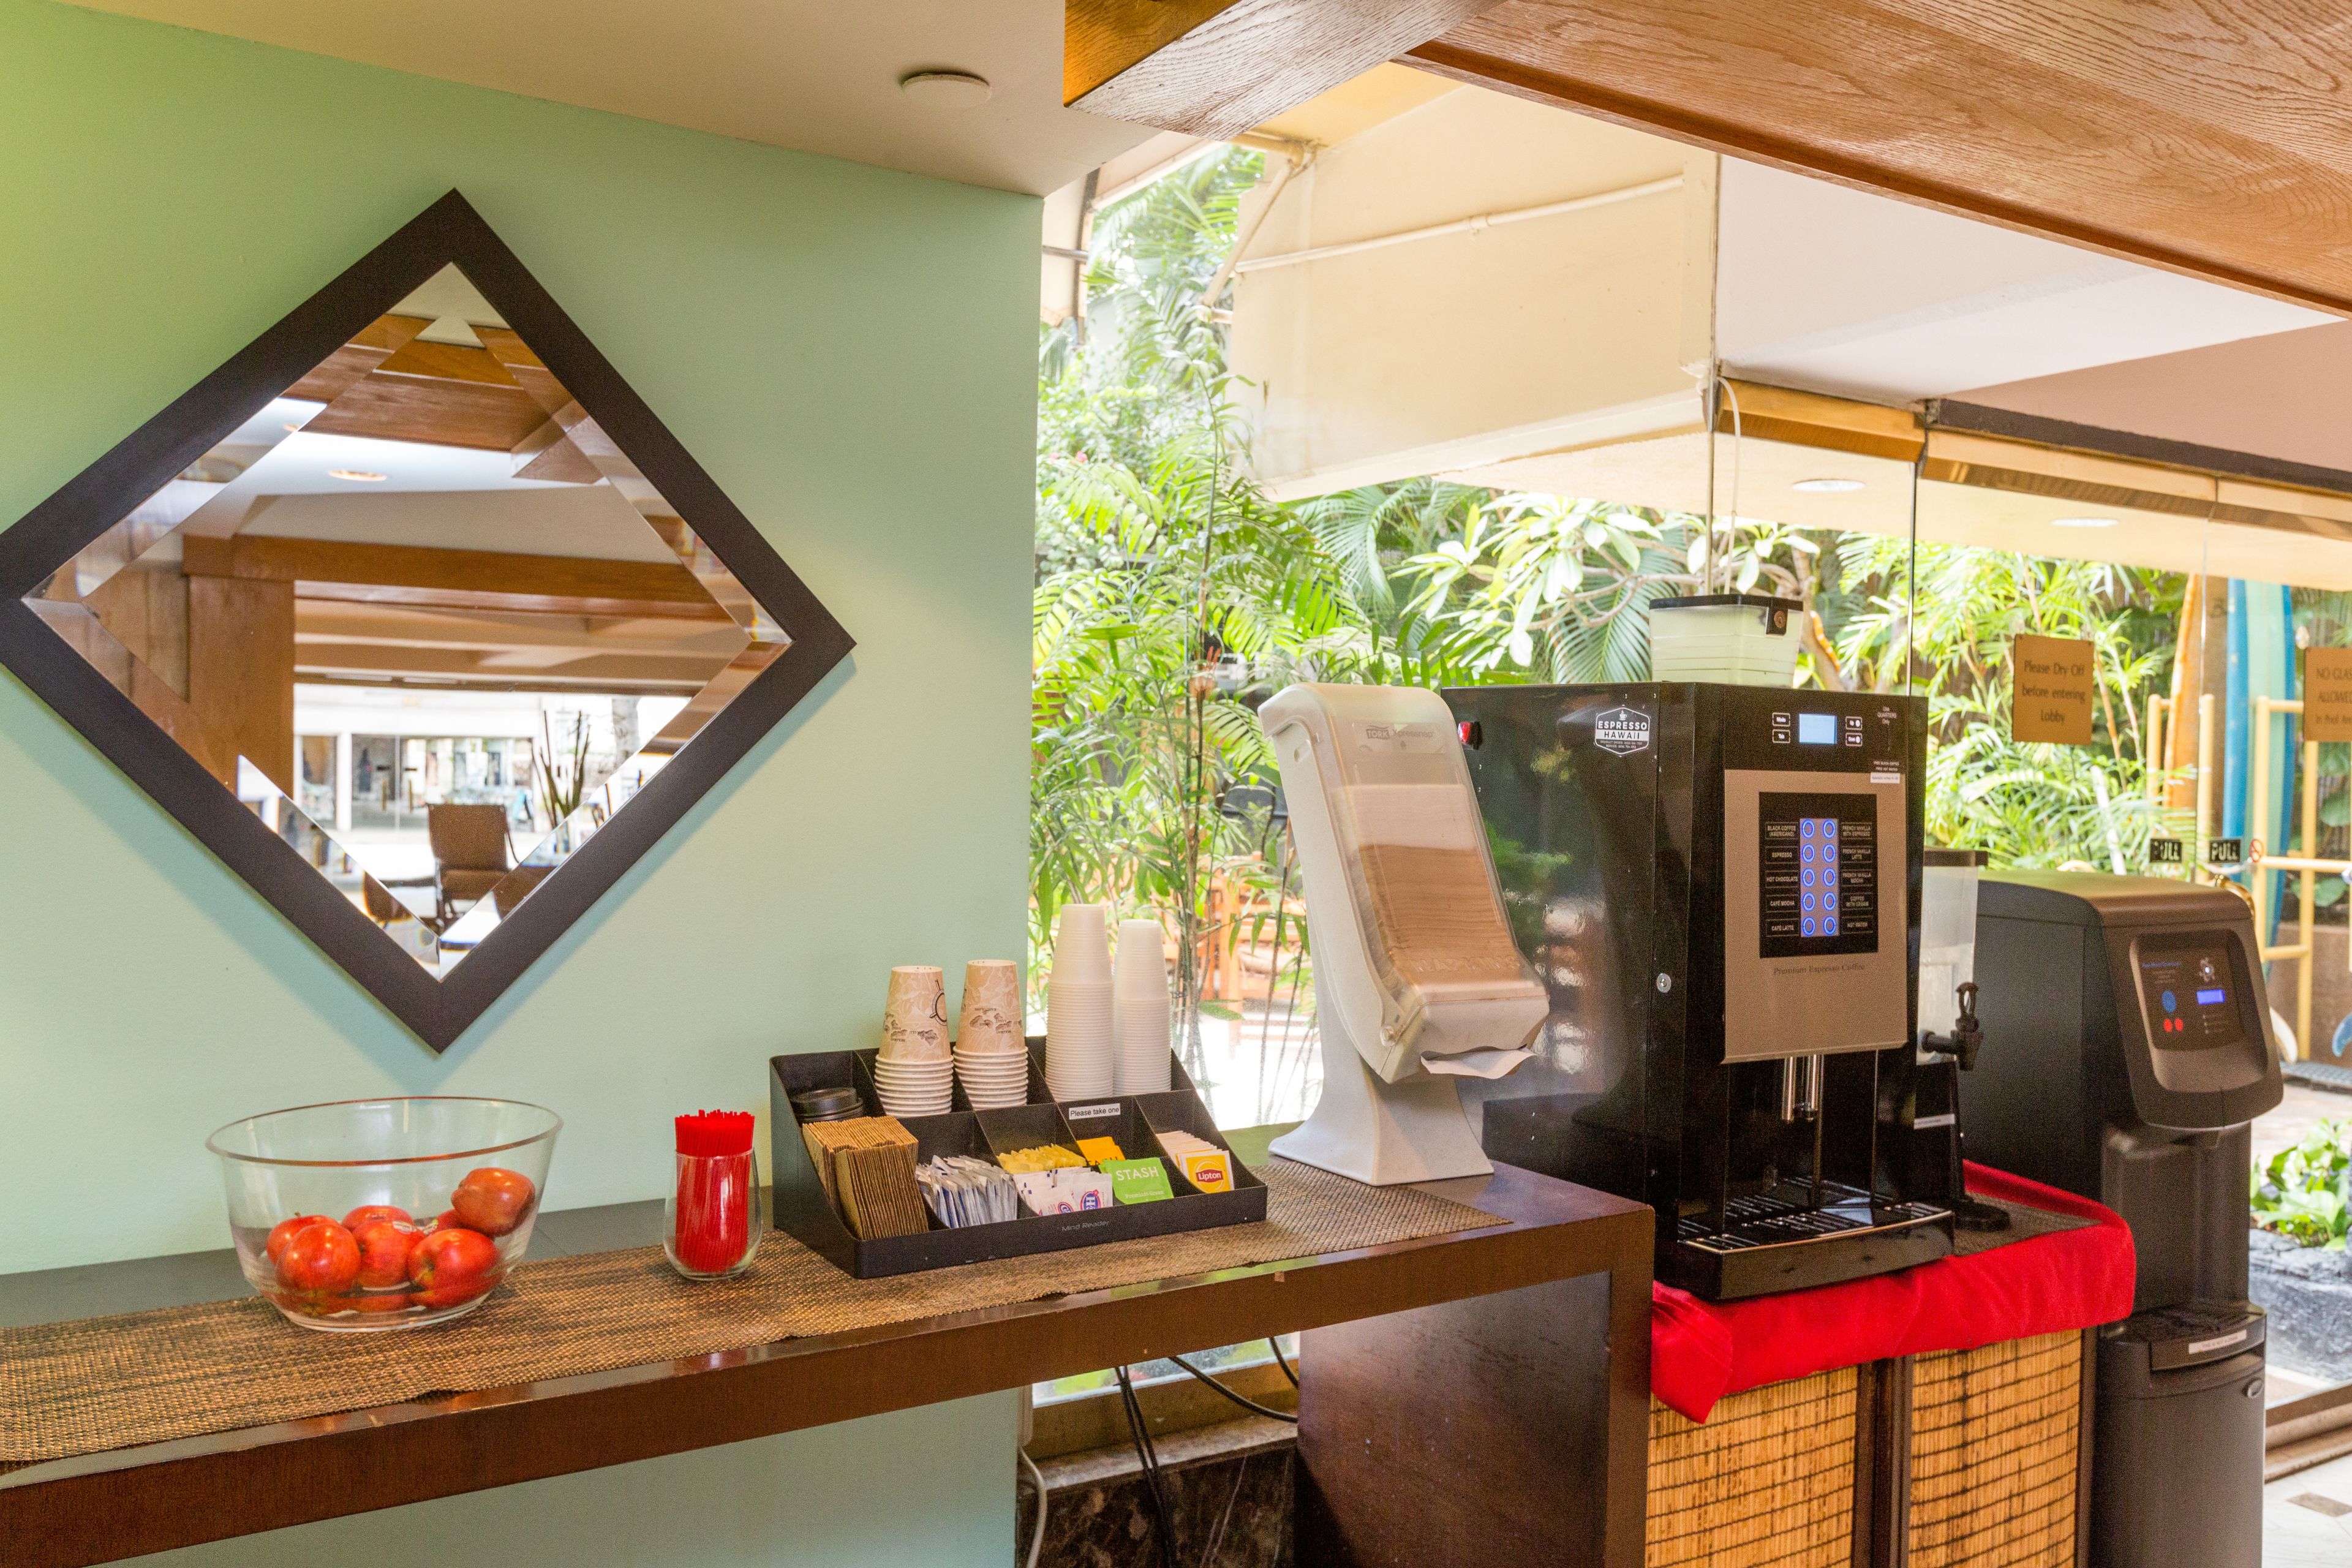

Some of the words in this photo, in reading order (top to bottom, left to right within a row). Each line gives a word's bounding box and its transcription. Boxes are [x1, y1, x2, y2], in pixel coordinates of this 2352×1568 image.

[2024, 660, 2049, 673] Please
[2053, 662, 2068, 677] Dry
[2071, 663, 2085, 676] Off
[2316, 667, 2330, 680] NO
[2022, 684, 2048, 697] before
[2052, 688, 2086, 704] entering
[2040, 709, 2065, 725] Lobby
[1597, 721, 1648, 730] ESPRESSO
[1367, 729, 1389, 739] TORK
[1604, 731, 1640, 739] HAWAII
[2211, 842, 2238, 861] PULL
[1409, 955, 1520, 973] NAPKINS
[1774, 966, 1807, 974] Premium
[1809, 964, 1840, 973] Espresso
[1841, 962, 1866, 971] Coffee
[1116, 1166, 1159, 1181] STASH
[1198, 1172, 1221, 1181] Lipton
